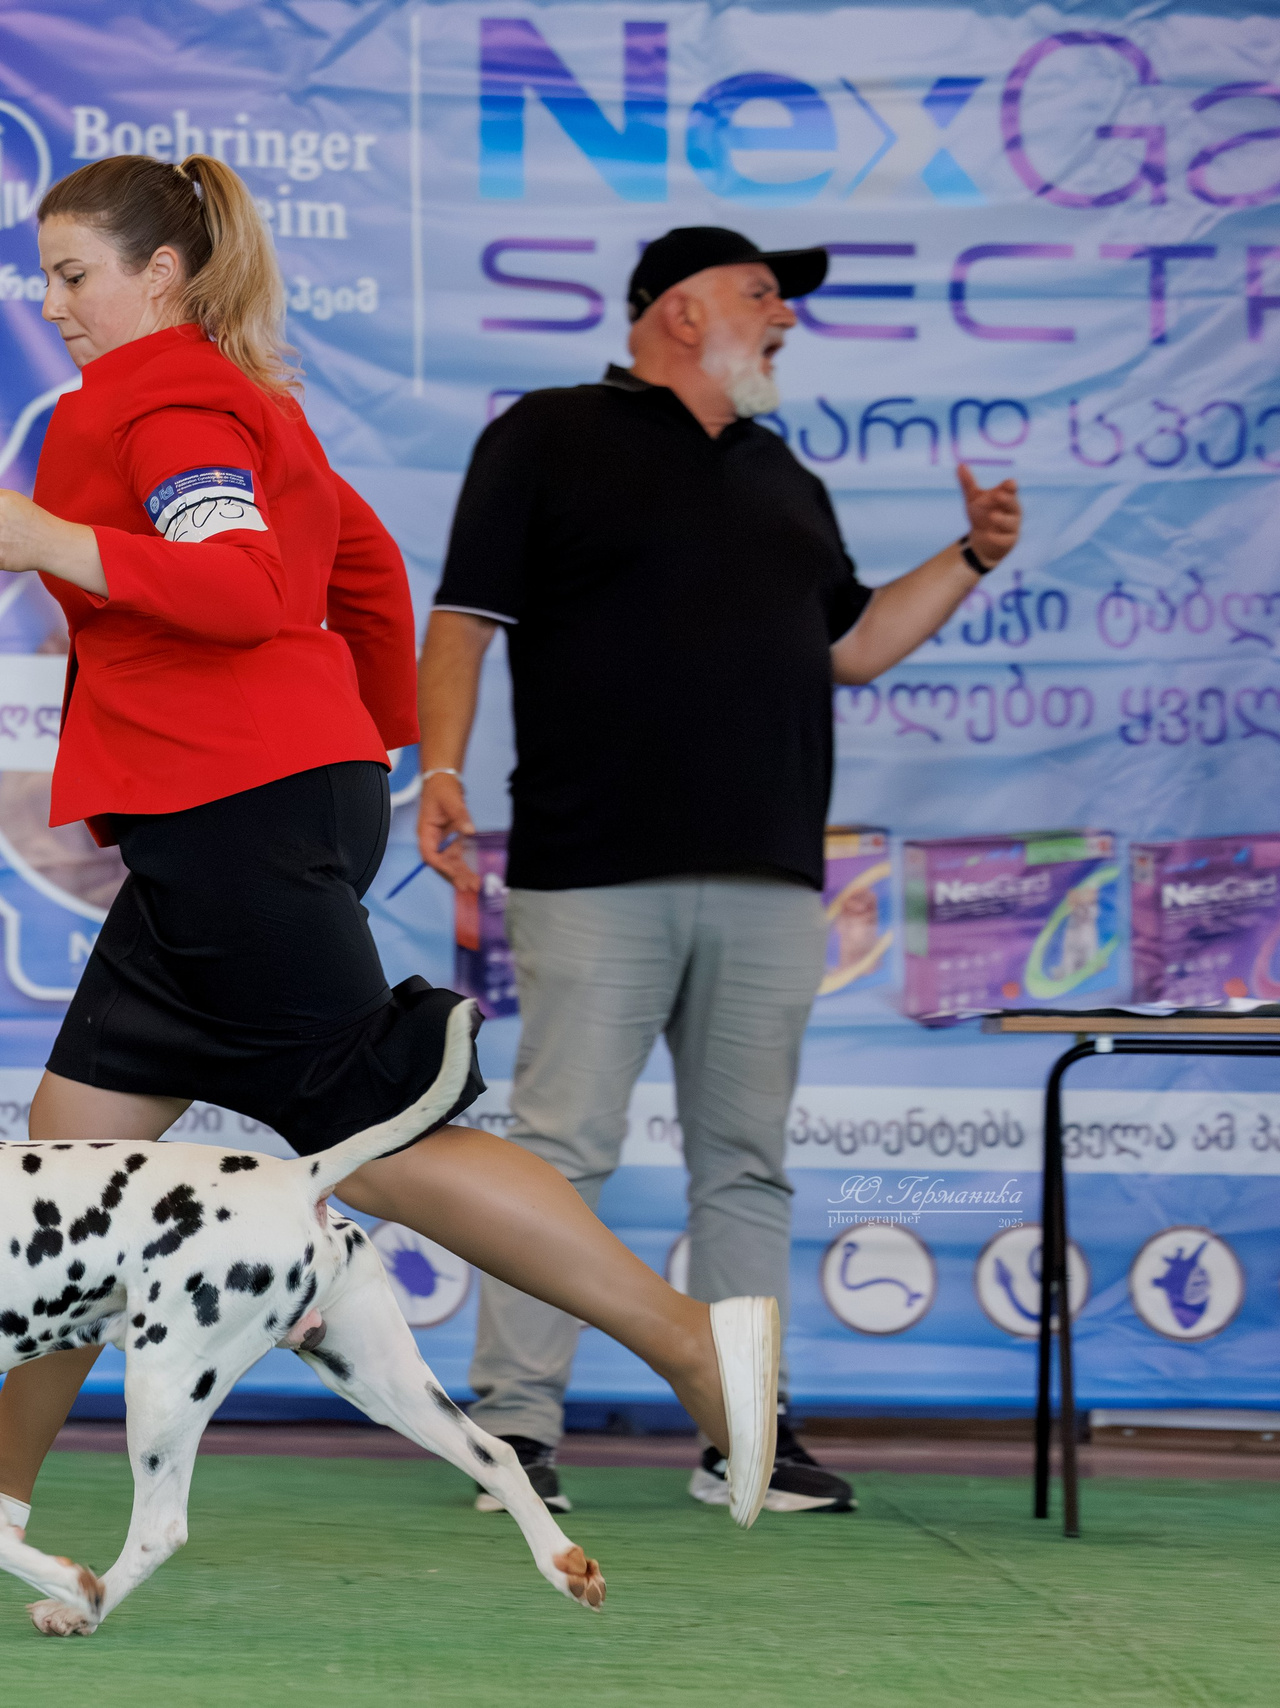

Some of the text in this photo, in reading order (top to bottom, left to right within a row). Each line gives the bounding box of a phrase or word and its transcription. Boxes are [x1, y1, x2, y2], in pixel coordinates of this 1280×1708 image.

[71, 105, 378, 182] Boehringer
[481, 236, 1280, 344] SECT
[1061, 1122, 1176, 1160] ველა
